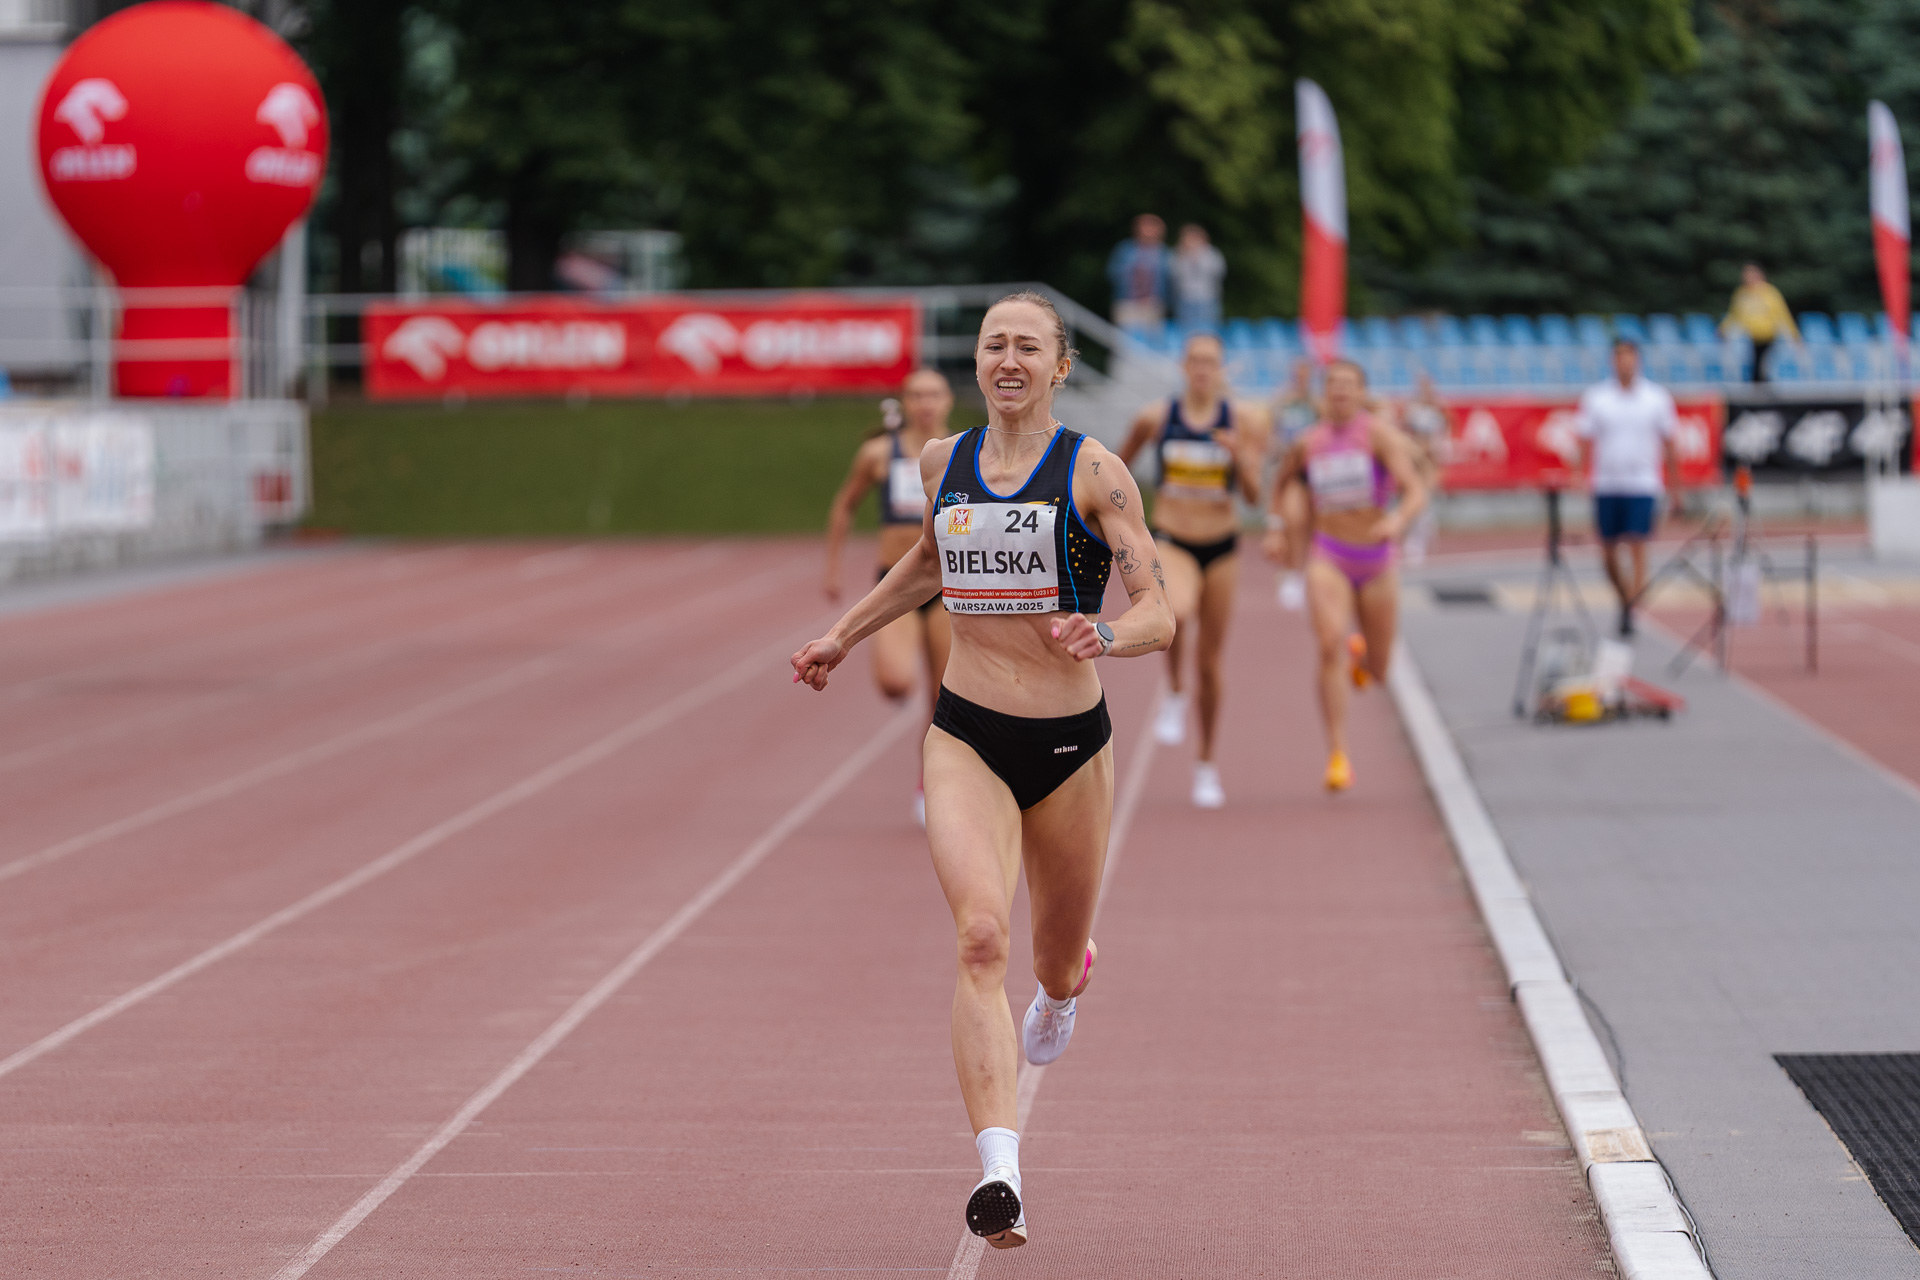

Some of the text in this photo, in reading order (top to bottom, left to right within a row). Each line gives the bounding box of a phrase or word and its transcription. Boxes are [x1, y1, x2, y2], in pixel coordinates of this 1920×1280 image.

[467, 321, 625, 371] ORLEN
[742, 319, 898, 369] ORLEN
[949, 525, 970, 534] PZLA
[1005, 509, 1038, 533] 24
[945, 550, 1046, 574] BIELSKA
[1001, 589, 1033, 598] wielobojach
[1034, 588, 1047, 597] (U23
[953, 602, 1044, 611] WARSZAWA 2025
